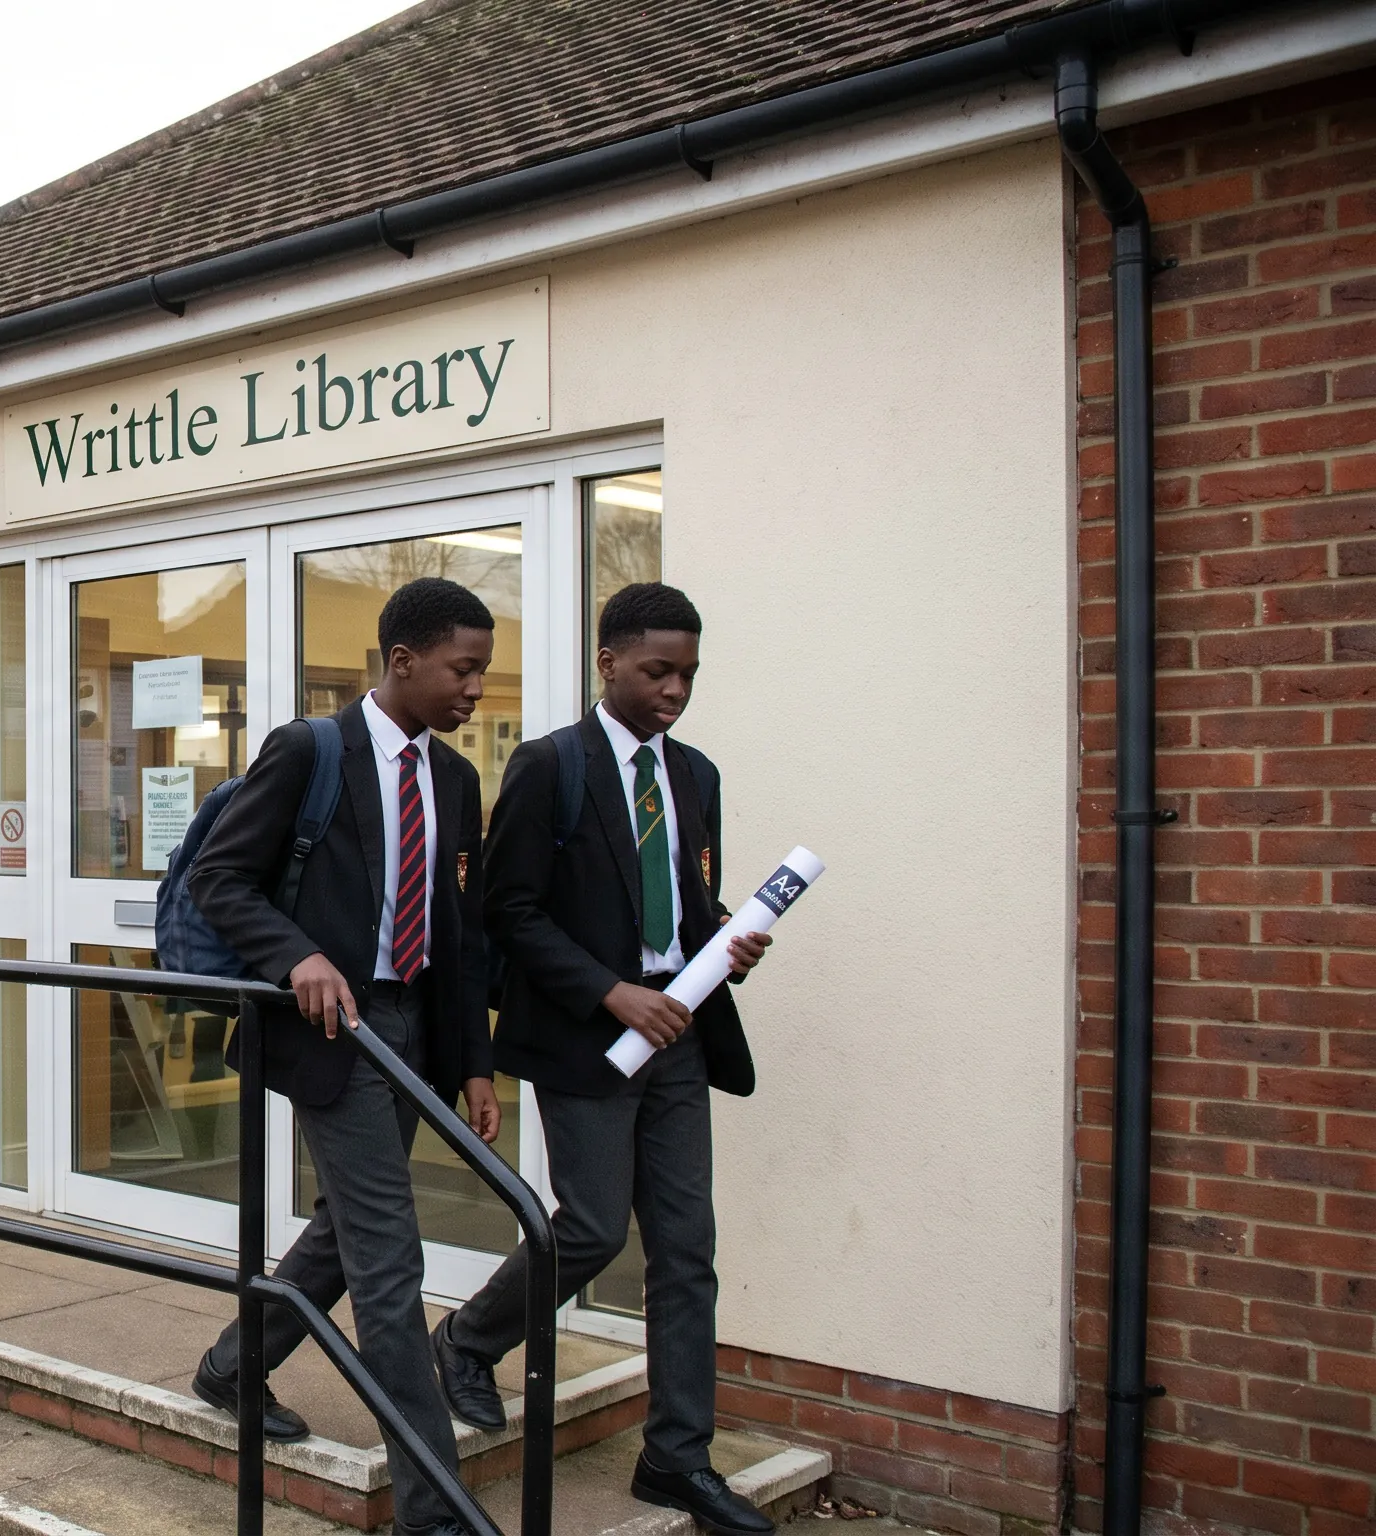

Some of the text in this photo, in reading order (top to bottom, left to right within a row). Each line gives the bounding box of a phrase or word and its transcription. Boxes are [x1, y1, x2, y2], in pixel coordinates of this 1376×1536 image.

[23, 338, 515, 487] Writtle Library
[770, 874, 800, 900] A4
